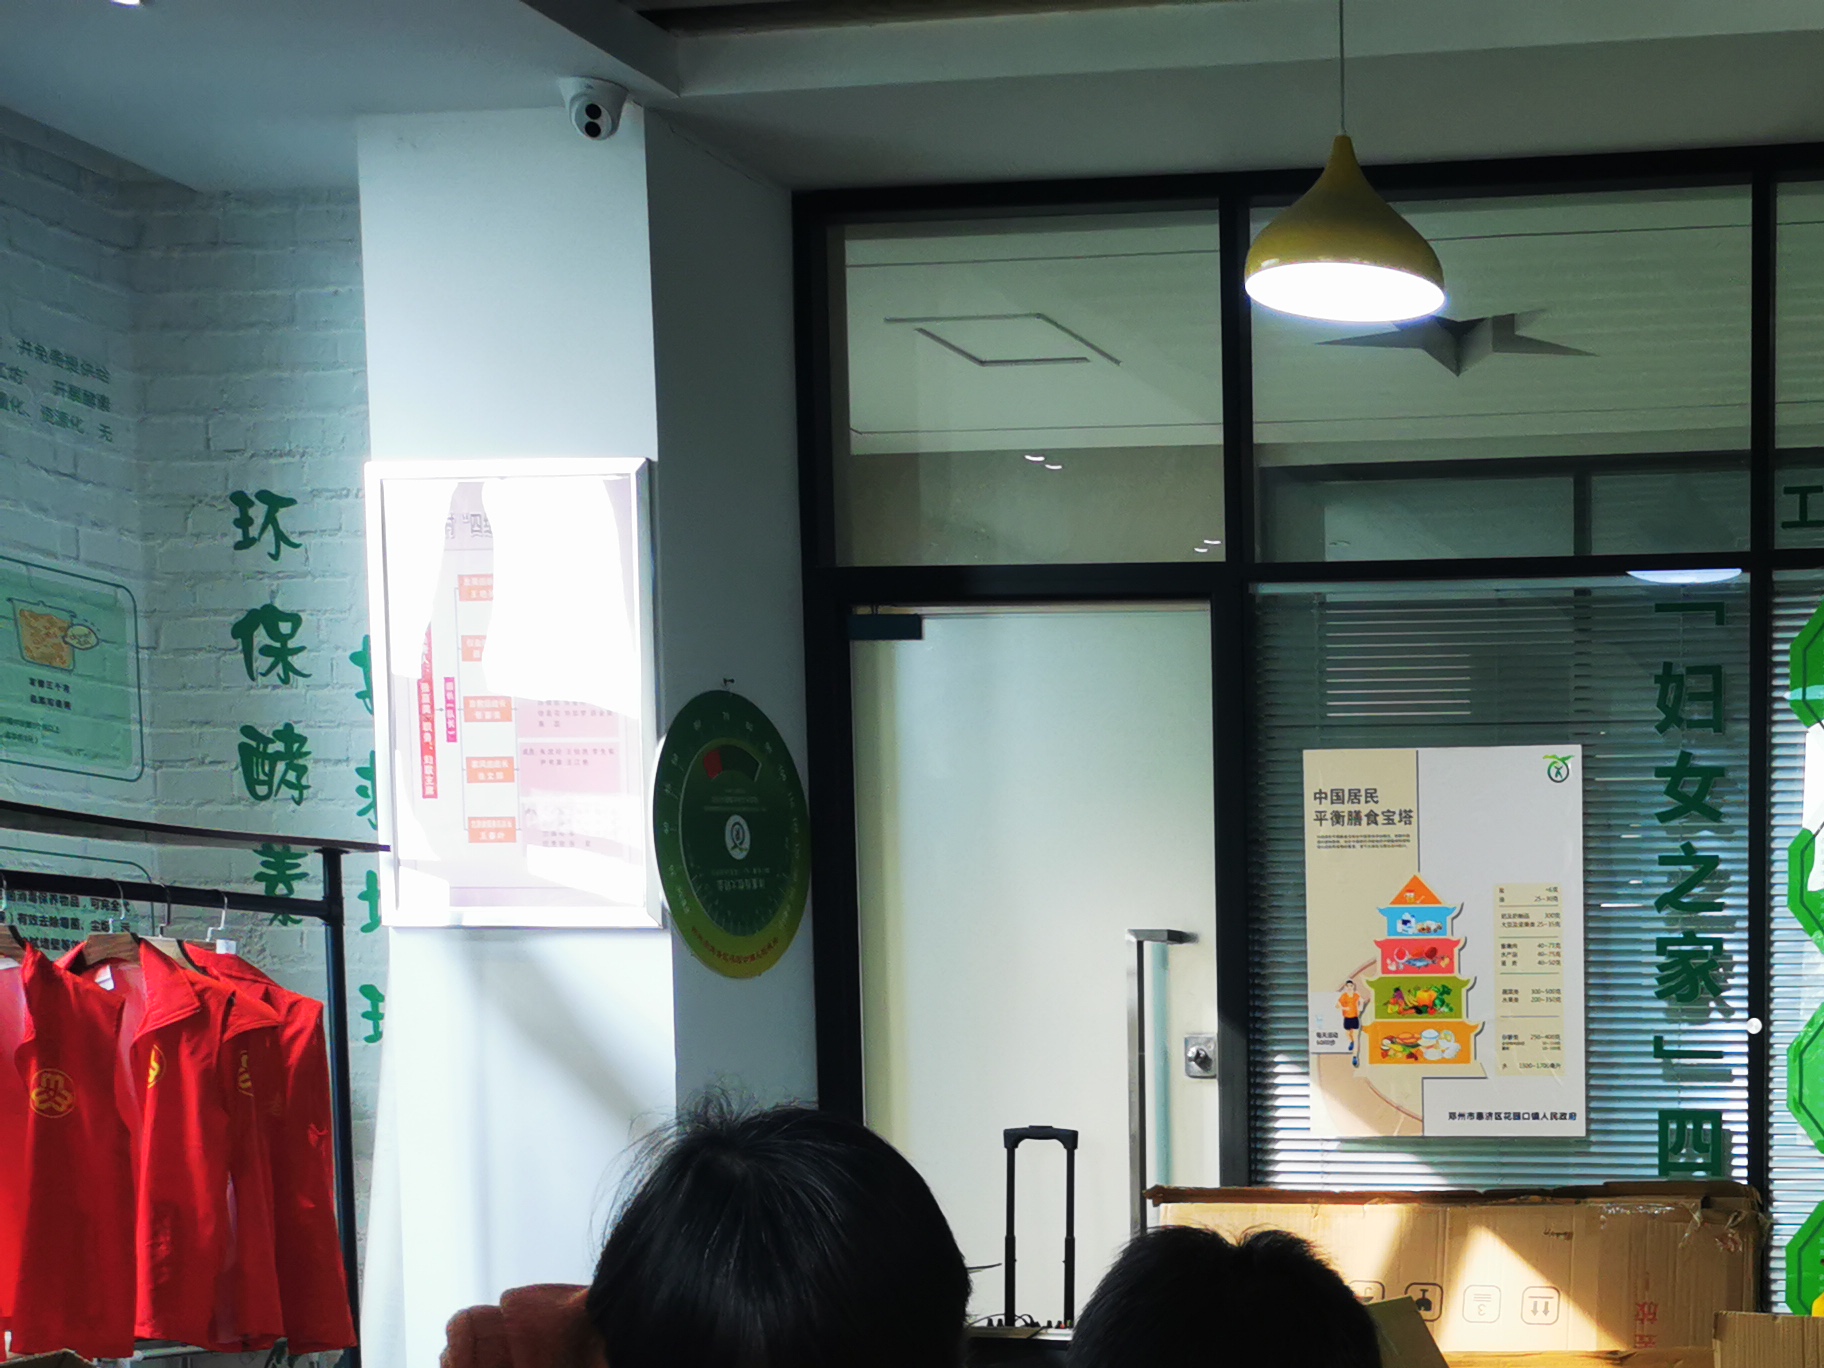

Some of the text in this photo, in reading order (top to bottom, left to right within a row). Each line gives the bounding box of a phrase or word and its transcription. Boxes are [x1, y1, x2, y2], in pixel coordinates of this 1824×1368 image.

[1313, 788, 1379, 806] 中国居民
[1313, 808, 1414, 827] 平衡膳食宝塔
[1447, 1111, 1578, 1122] 郑州市惠济区花园口镇人民政府
